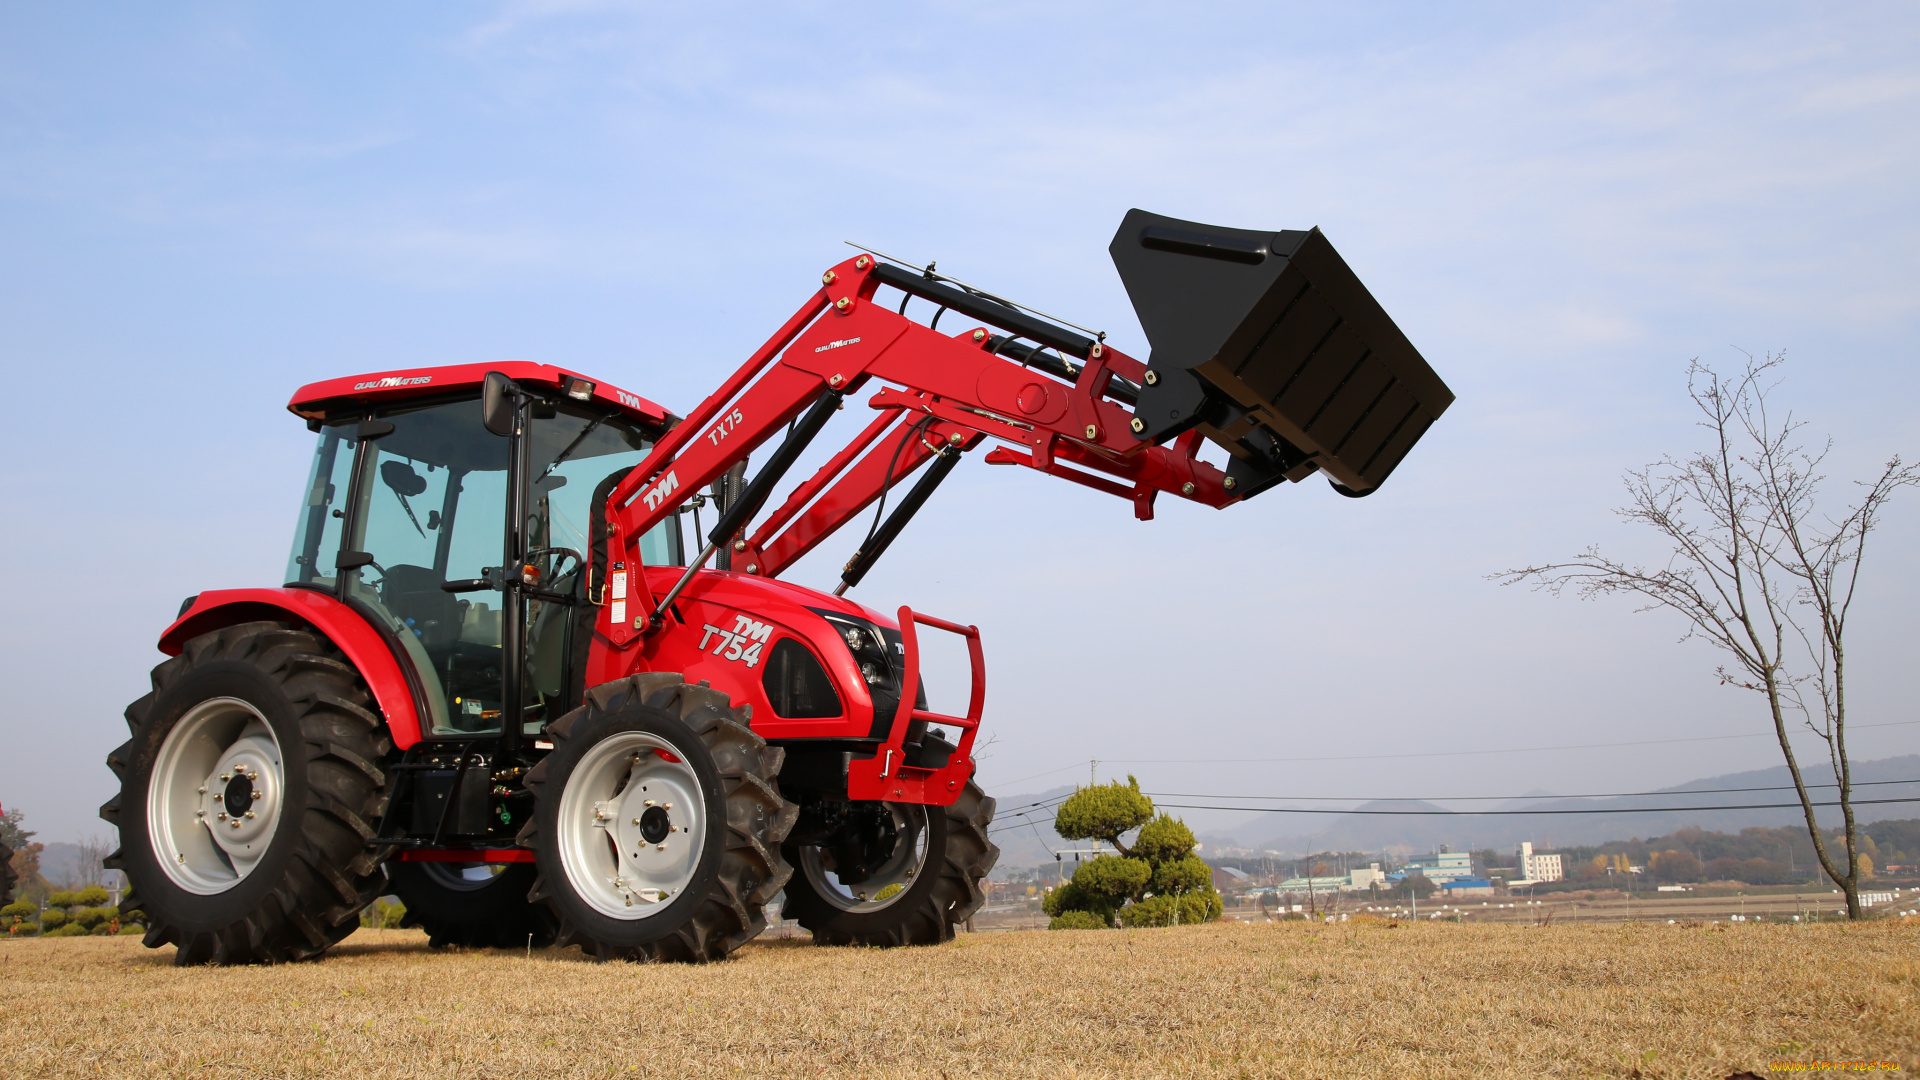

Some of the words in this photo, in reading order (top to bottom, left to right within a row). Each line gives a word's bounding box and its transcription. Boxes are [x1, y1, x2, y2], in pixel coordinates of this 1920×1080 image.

[616, 390, 641, 410] TYM
[708, 408, 743, 446] TX75
[643, 470, 679, 512] TYM
[698, 623, 764, 668] T754
[732, 614, 774, 644] TYM
